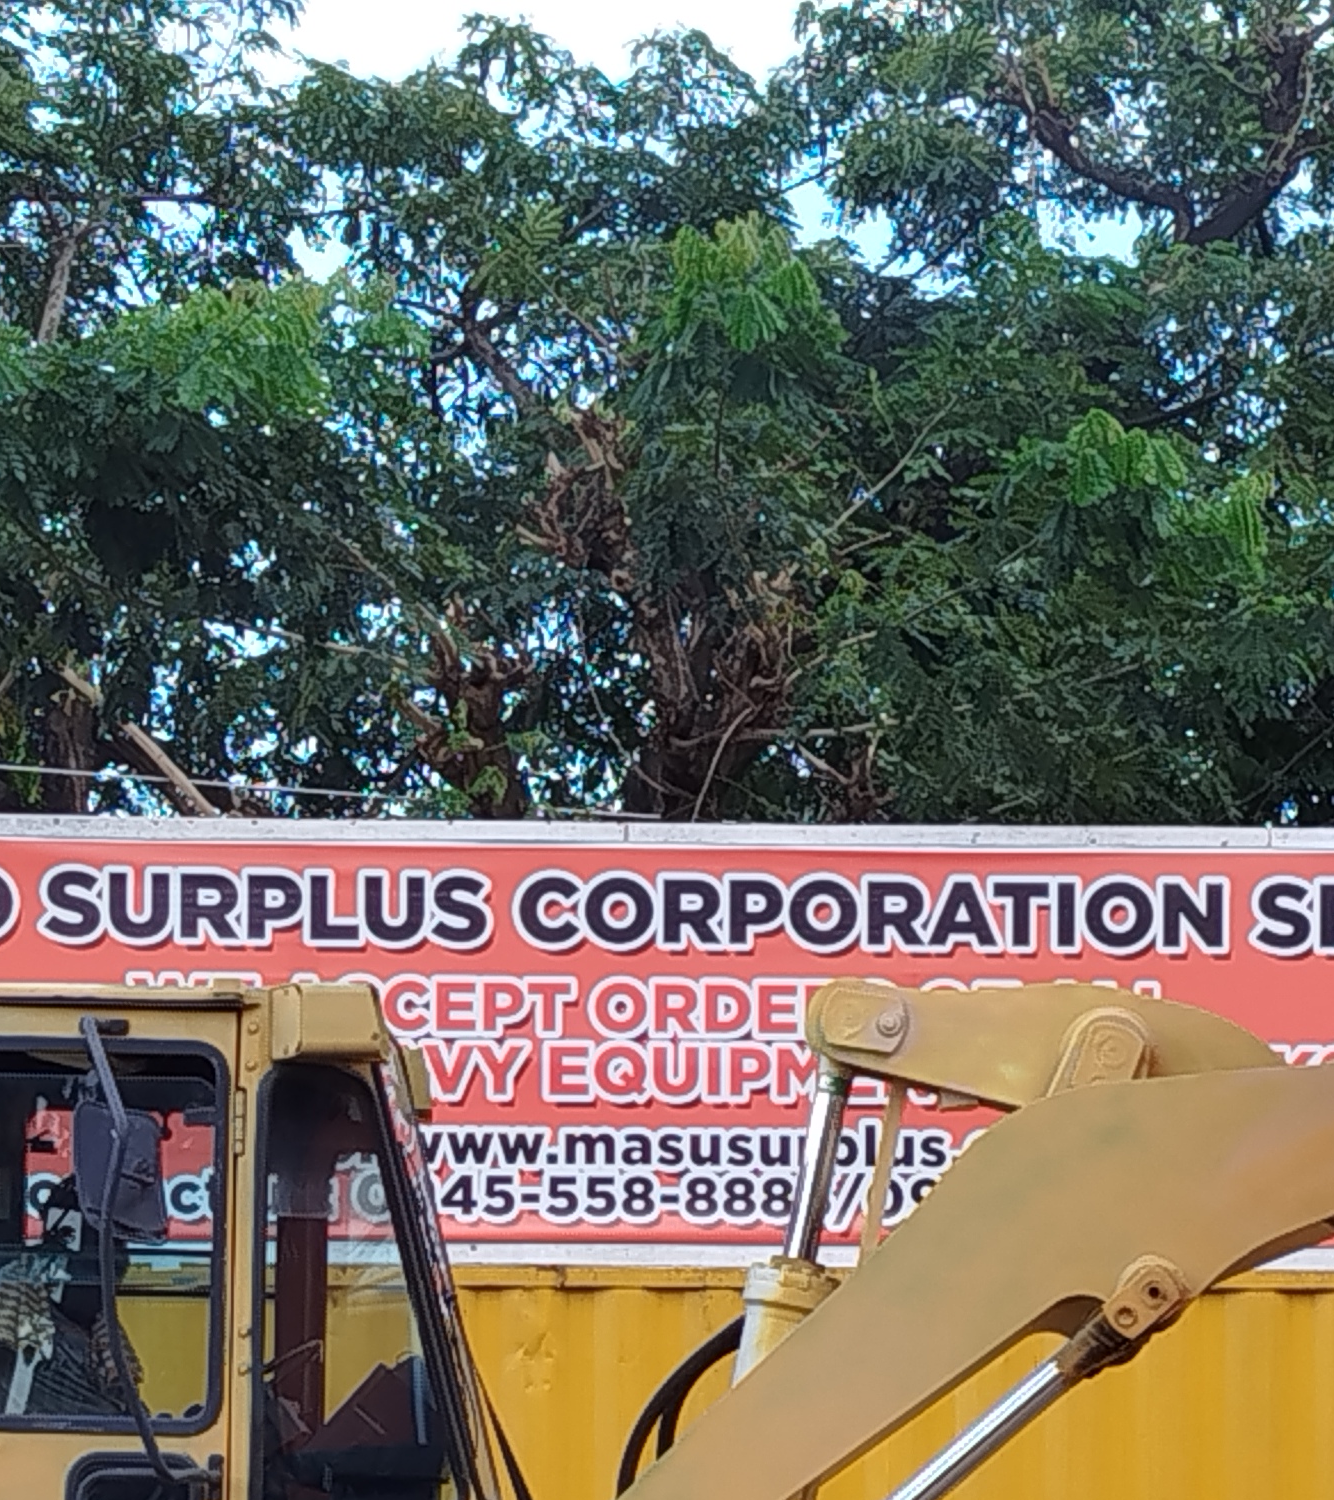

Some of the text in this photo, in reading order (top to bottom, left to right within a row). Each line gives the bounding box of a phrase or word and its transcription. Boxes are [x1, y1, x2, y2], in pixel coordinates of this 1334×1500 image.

[38, 863, 493, 947] SURPLUS
[514, 868, 1227, 954] CORPORATION
[296, 974, 895, 1038] CEPT ORDE
